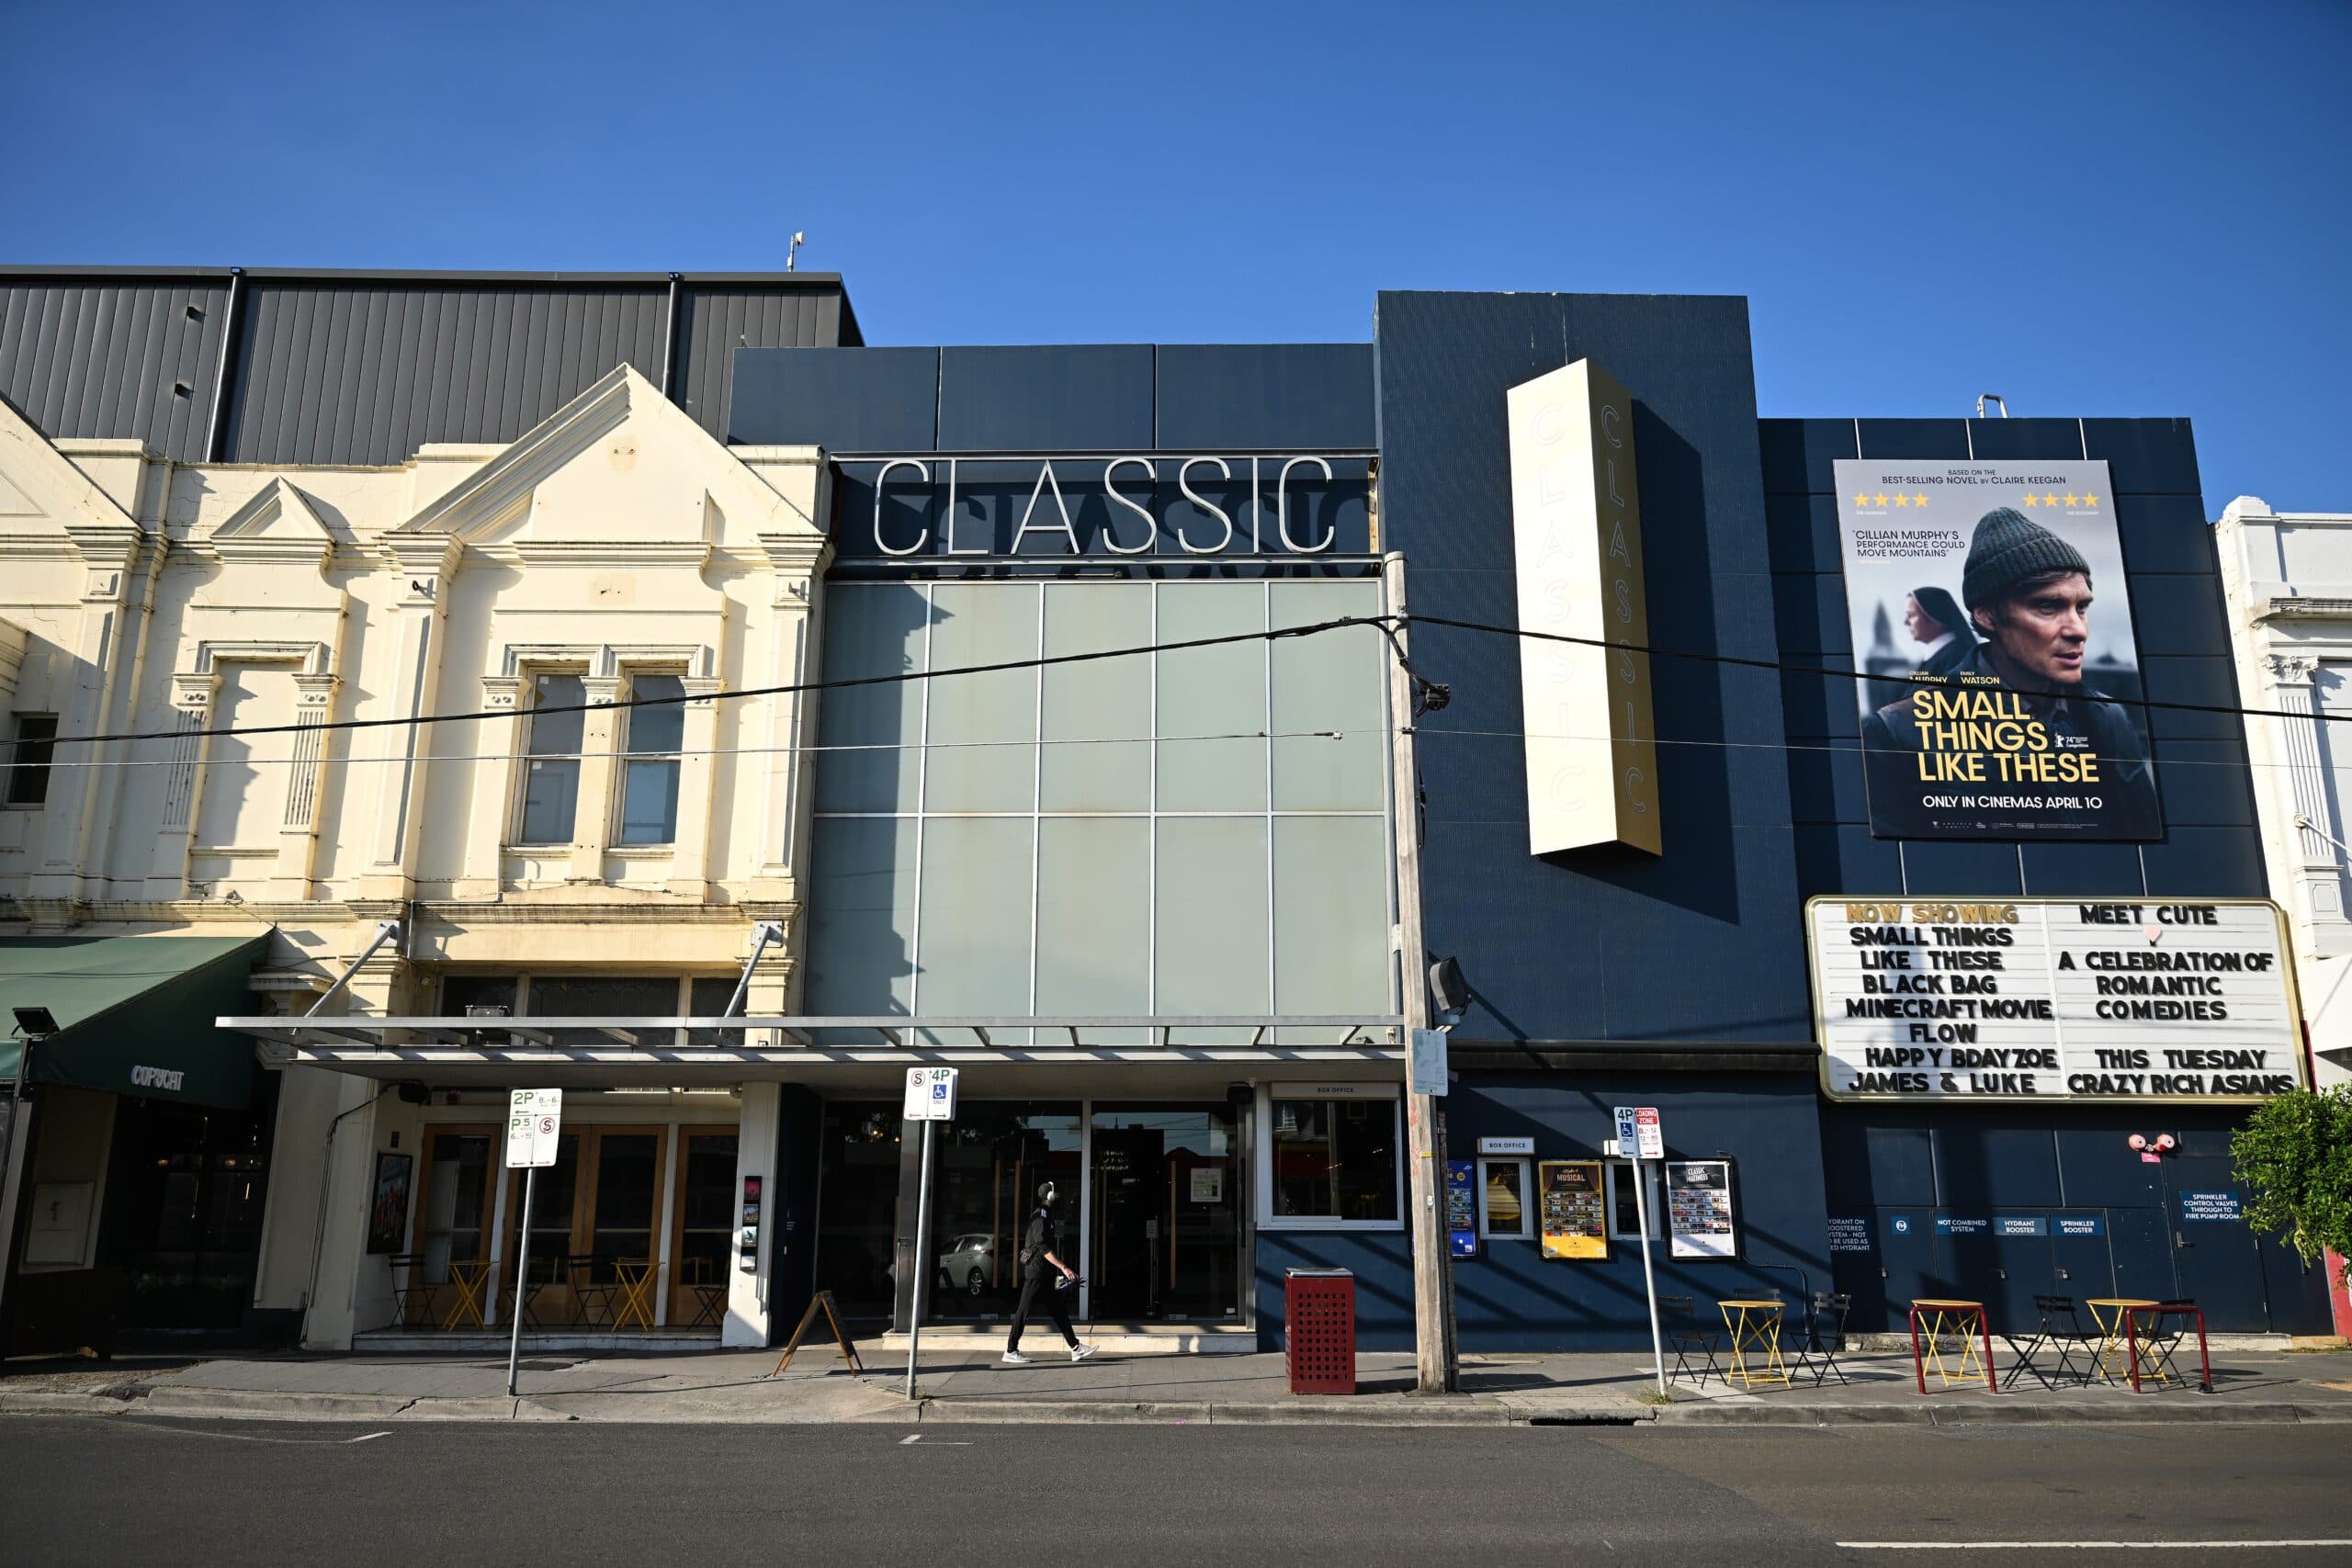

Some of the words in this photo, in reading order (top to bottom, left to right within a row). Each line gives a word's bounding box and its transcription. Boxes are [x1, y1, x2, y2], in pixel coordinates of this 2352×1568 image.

[874, 457, 1335, 555] CLASSIC
[1856, 540, 1928, 548] PERFORMANCE
[1901, 530, 1960, 540] MURPHY'S
[1858, 549, 1890, 558] MOVE
[1531, 403, 1587, 812] CLASSIC
[1601, 404, 1646, 815] CLASSIC
[1961, 676, 2000, 684] WATSON
[1913, 690, 2031, 720] SMALL
[1914, 721, 2049, 751] THINGS
[1917, 752, 1986, 782] LIKE
[1993, 753, 2099, 783] THESE
[1922, 795, 1959, 808] ONLY
[1962, 795, 1975, 808] IN
[1978, 795, 2042, 808] CINEMAS
[2045, 795, 2083, 809] APRIL
[2086, 796, 2103, 809] 10
[1846, 905, 1902, 924] NOW
[1912, 905, 2019, 924] SHOWING
[2079, 905, 2143, 925] MEET
[2156, 906, 2218, 925] CUTE
[1849, 926, 1929, 946] SMALL
[1931, 927, 2013, 946] THINGS
[1860, 951, 1911, 970] LIKE
[1928, 951, 2003, 970] THESE
[2058, 951, 2075, 971] A
[2085, 952, 2241, 972] CELEBRATION
[2244, 953, 2273, 972] OF
[1862, 975, 1944, 994] BLACK
[1951, 975, 1998, 994] BAG
[2096, 976, 2222, 996] ROMANTIC
[1846, 998, 1977, 1019] MINECRAFT
[1980, 999, 2052, 1020] MOVIE
[2095, 1000, 2227, 1021] COMEDIES
[1909, 1023, 1977, 1043] FLOW
[1865, 1047, 1943, 1068] HAPPY
[1951, 1048, 2010, 1068] BDAY
[2012, 1049, 2058, 1069] ZOE
[2094, 1049, 2149, 1069] THIS
[2163, 1049, 2267, 1069] TUESDAY
[131, 1066, 184, 1091] COPYCAT
[932, 1069, 950, 1081] 4P
[1849, 1072, 1929, 1092] JAMES
[1939, 1073, 1959, 1092] &
[1970, 1073, 2036, 1093] LUKE
[2067, 1073, 2145, 1094] CRAZY
[2150, 1074, 2205, 1094] RICH
[2210, 1075, 2294, 1094] ASIANS
[514, 1092, 534, 1105] 2P
[512, 1119, 521, 1131] P
[1618, 1109, 1633, 1121] 4P
[1556, 1174, 1586, 1182] MUSICAL
